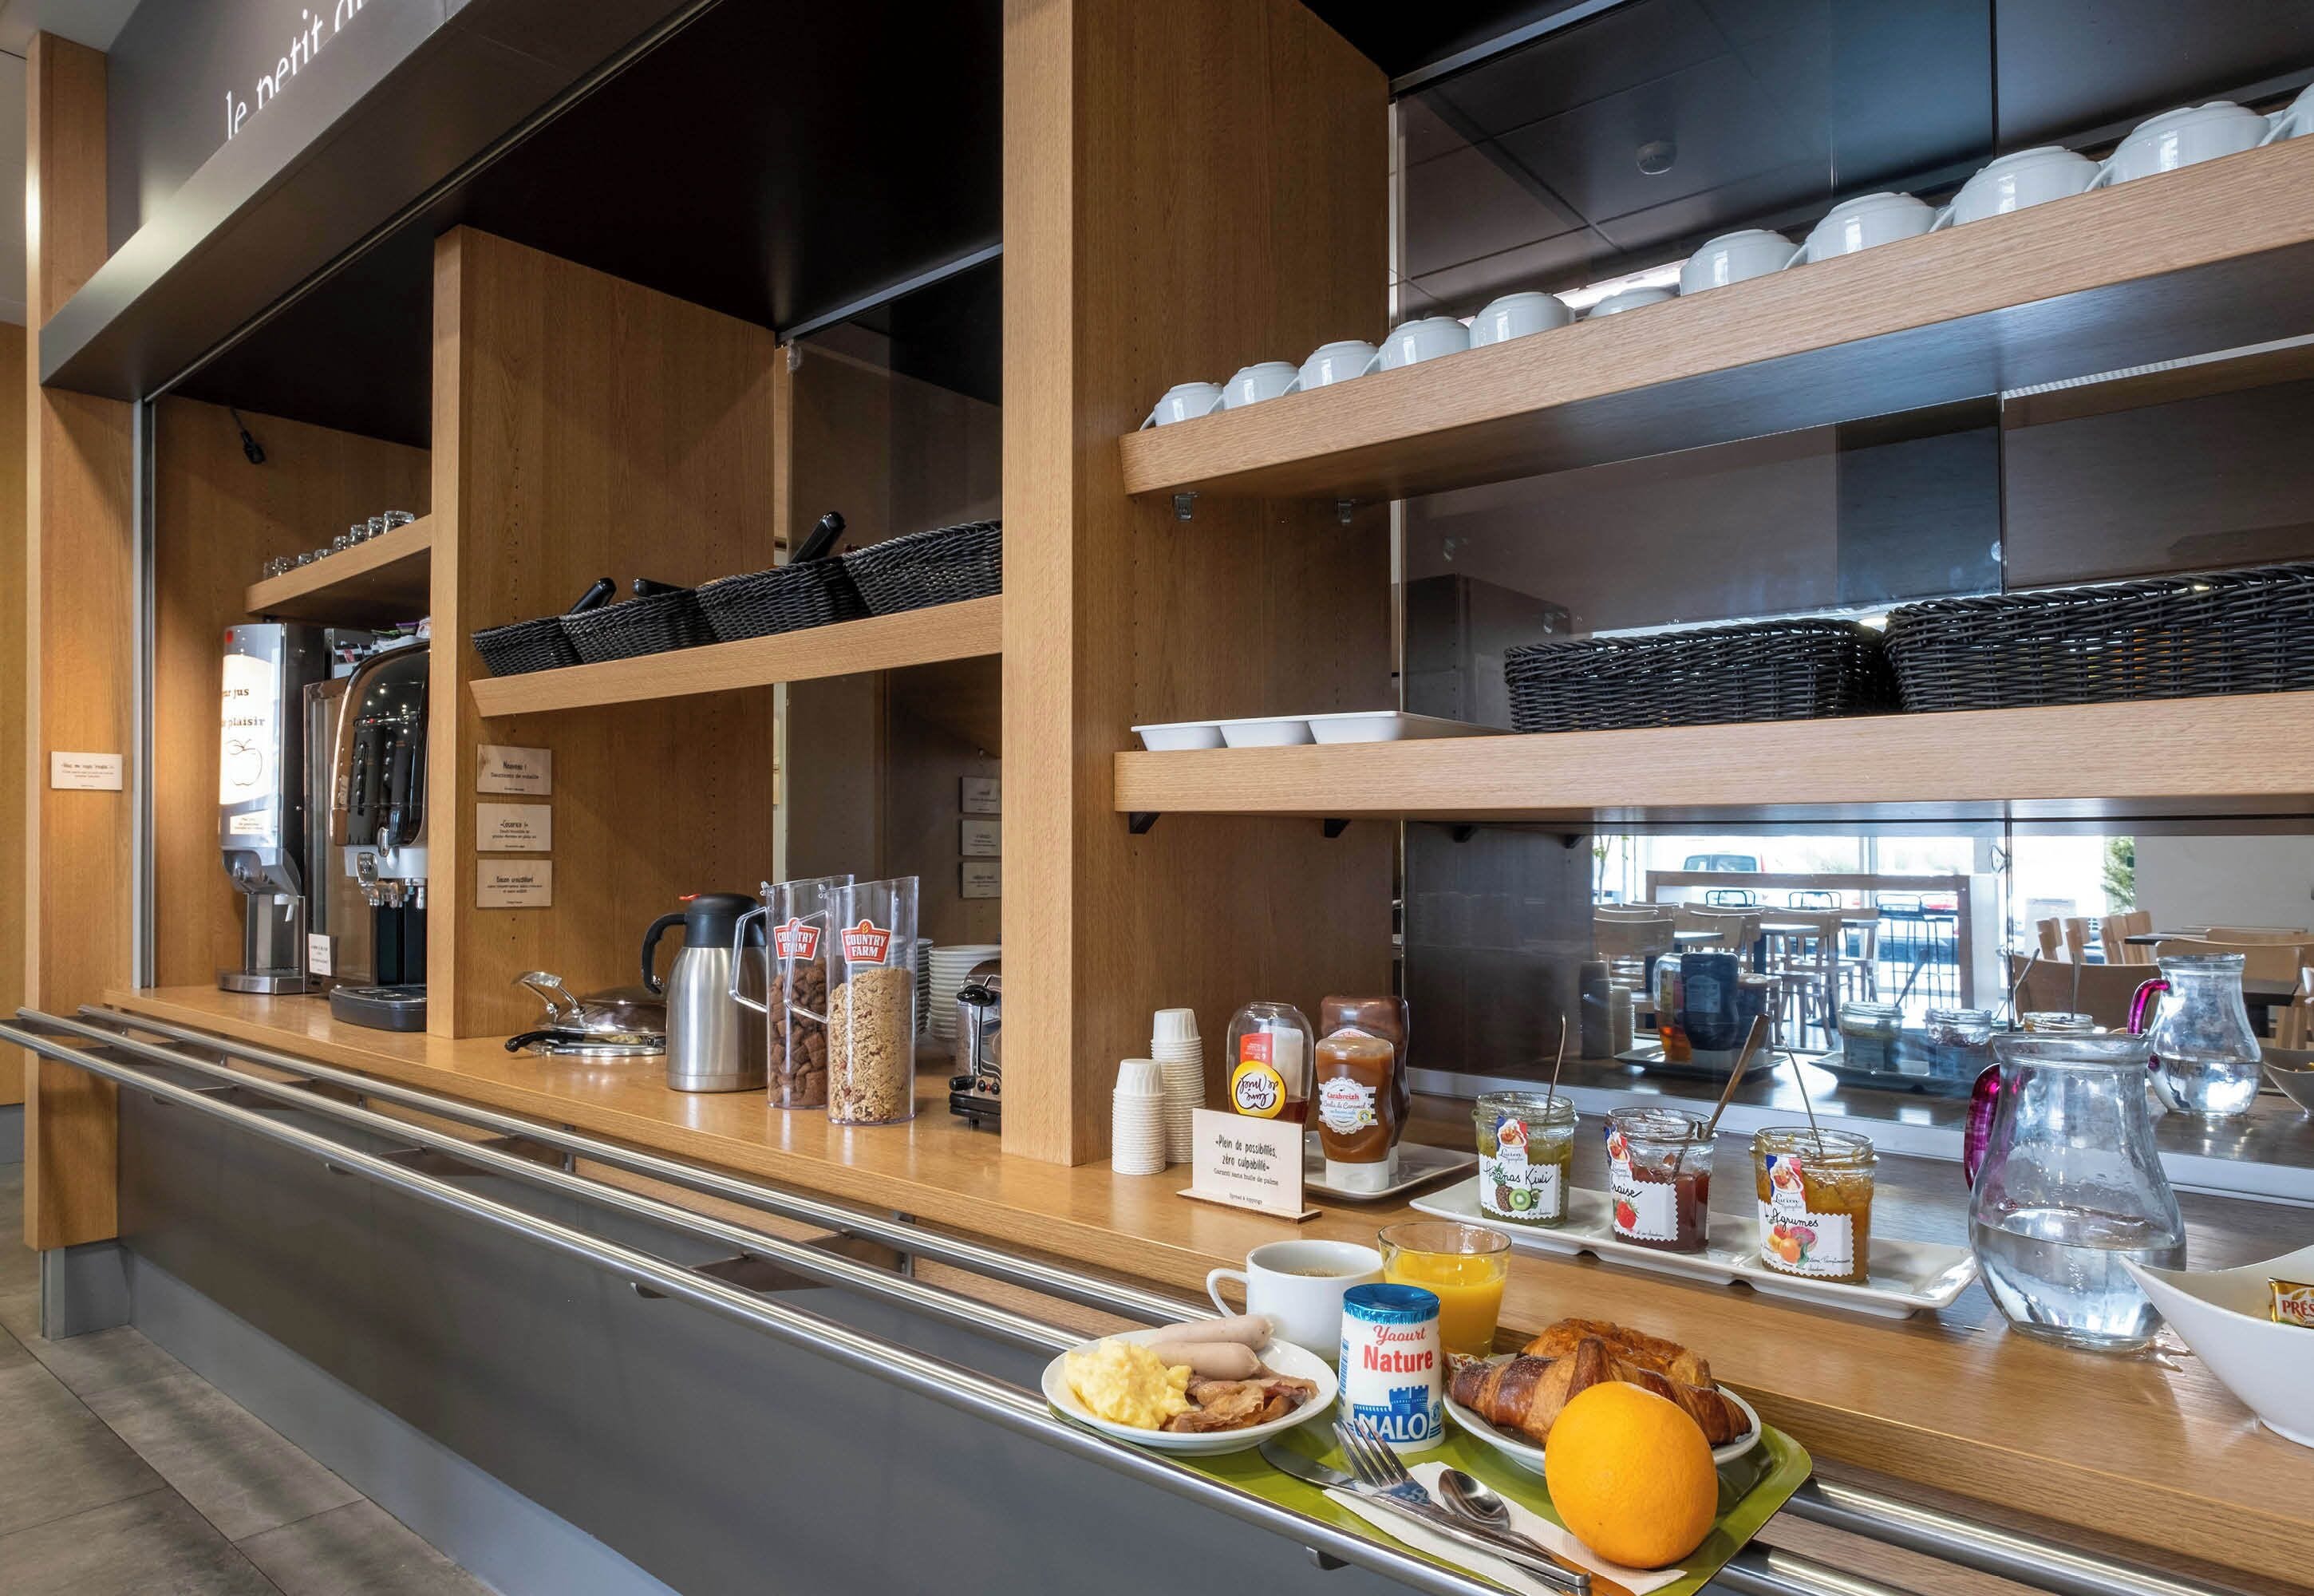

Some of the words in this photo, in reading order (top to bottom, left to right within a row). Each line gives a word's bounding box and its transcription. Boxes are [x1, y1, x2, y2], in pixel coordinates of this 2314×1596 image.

[845, 934, 887, 947] COUNTRY
[851, 946, 879, 958] FARM
[1235, 1139, 1242, 1152] de
[1525, 1167, 1553, 1186] Kiwi
[1611, 1181, 1643, 1198] raise
[1771, 1207, 1819, 1233] Agrumes
[1372, 1325, 1427, 1345] Yaourt
[1363, 1344, 1434, 1374] Nature
[1355, 1412, 1428, 1441] MALO
